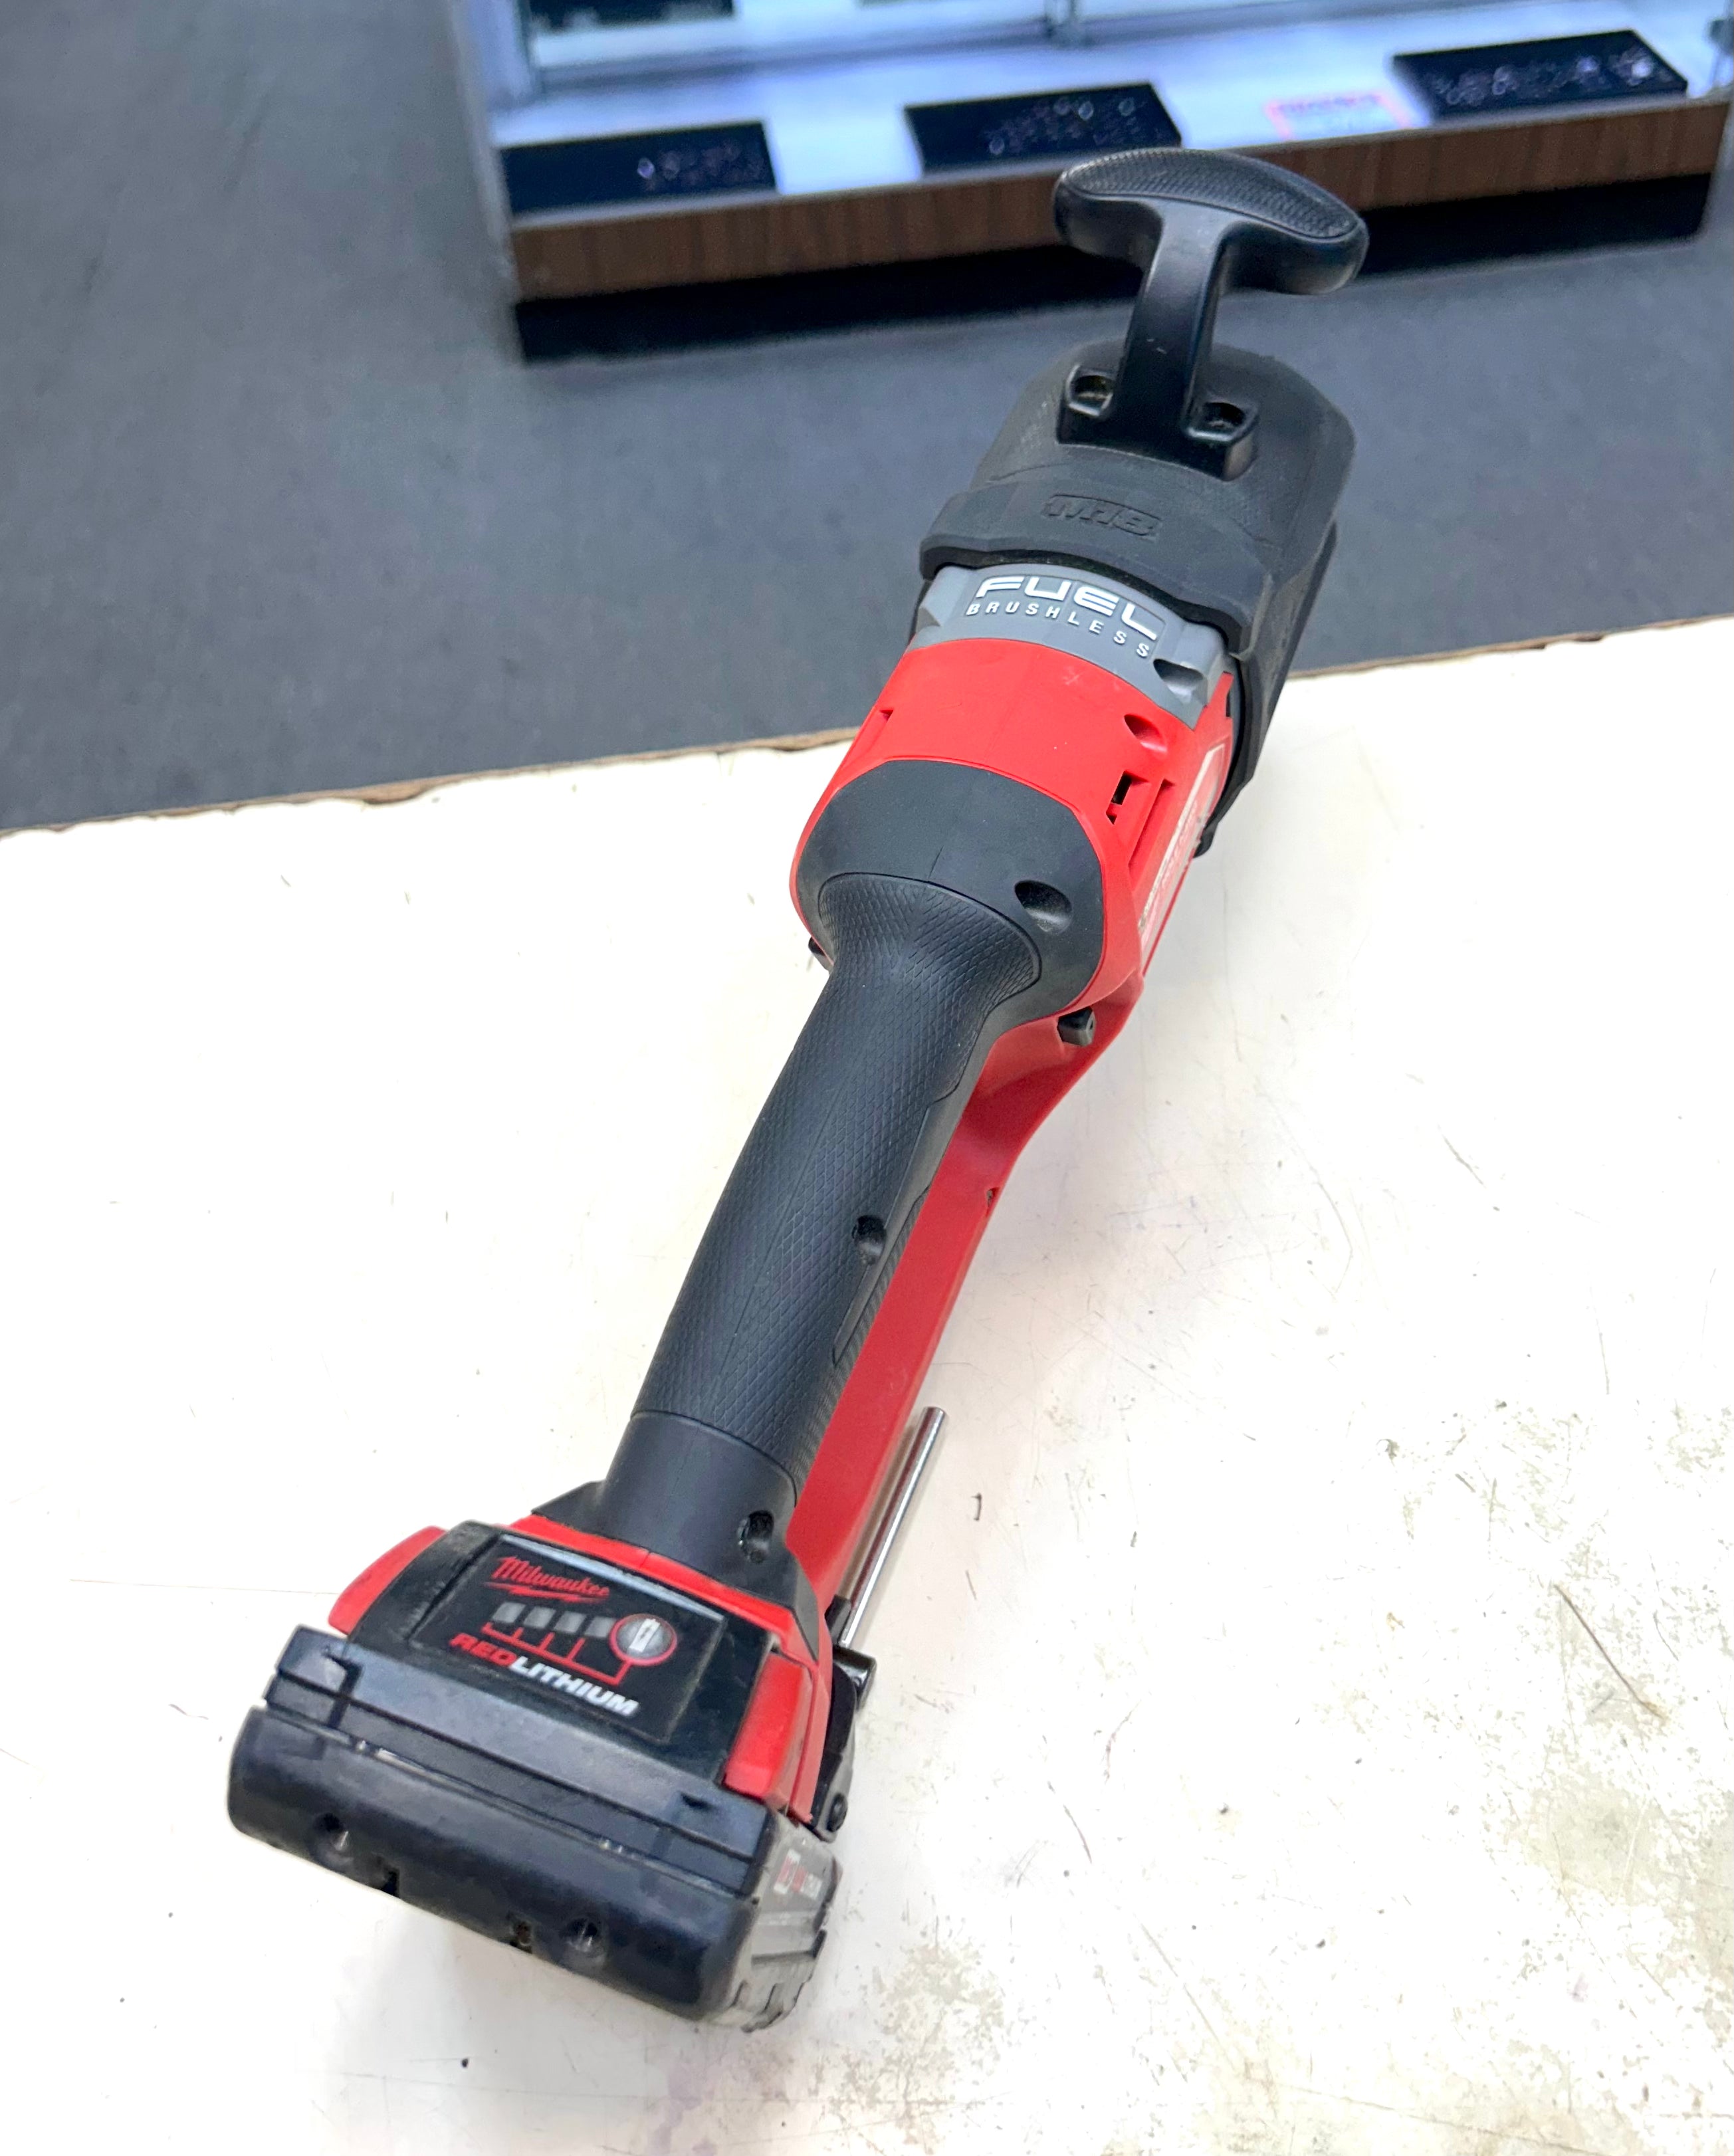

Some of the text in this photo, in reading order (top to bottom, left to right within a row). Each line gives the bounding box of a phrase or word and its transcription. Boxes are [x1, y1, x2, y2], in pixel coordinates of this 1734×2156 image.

[1042, 494, 1161, 538] M18
[966, 602, 1150, 657] BRUSHLESS
[975, 576, 1157, 640] FUEL
[490, 1557, 609, 1596] Milwaukee
[449, 1634, 639, 1716] REDLITHIUM
